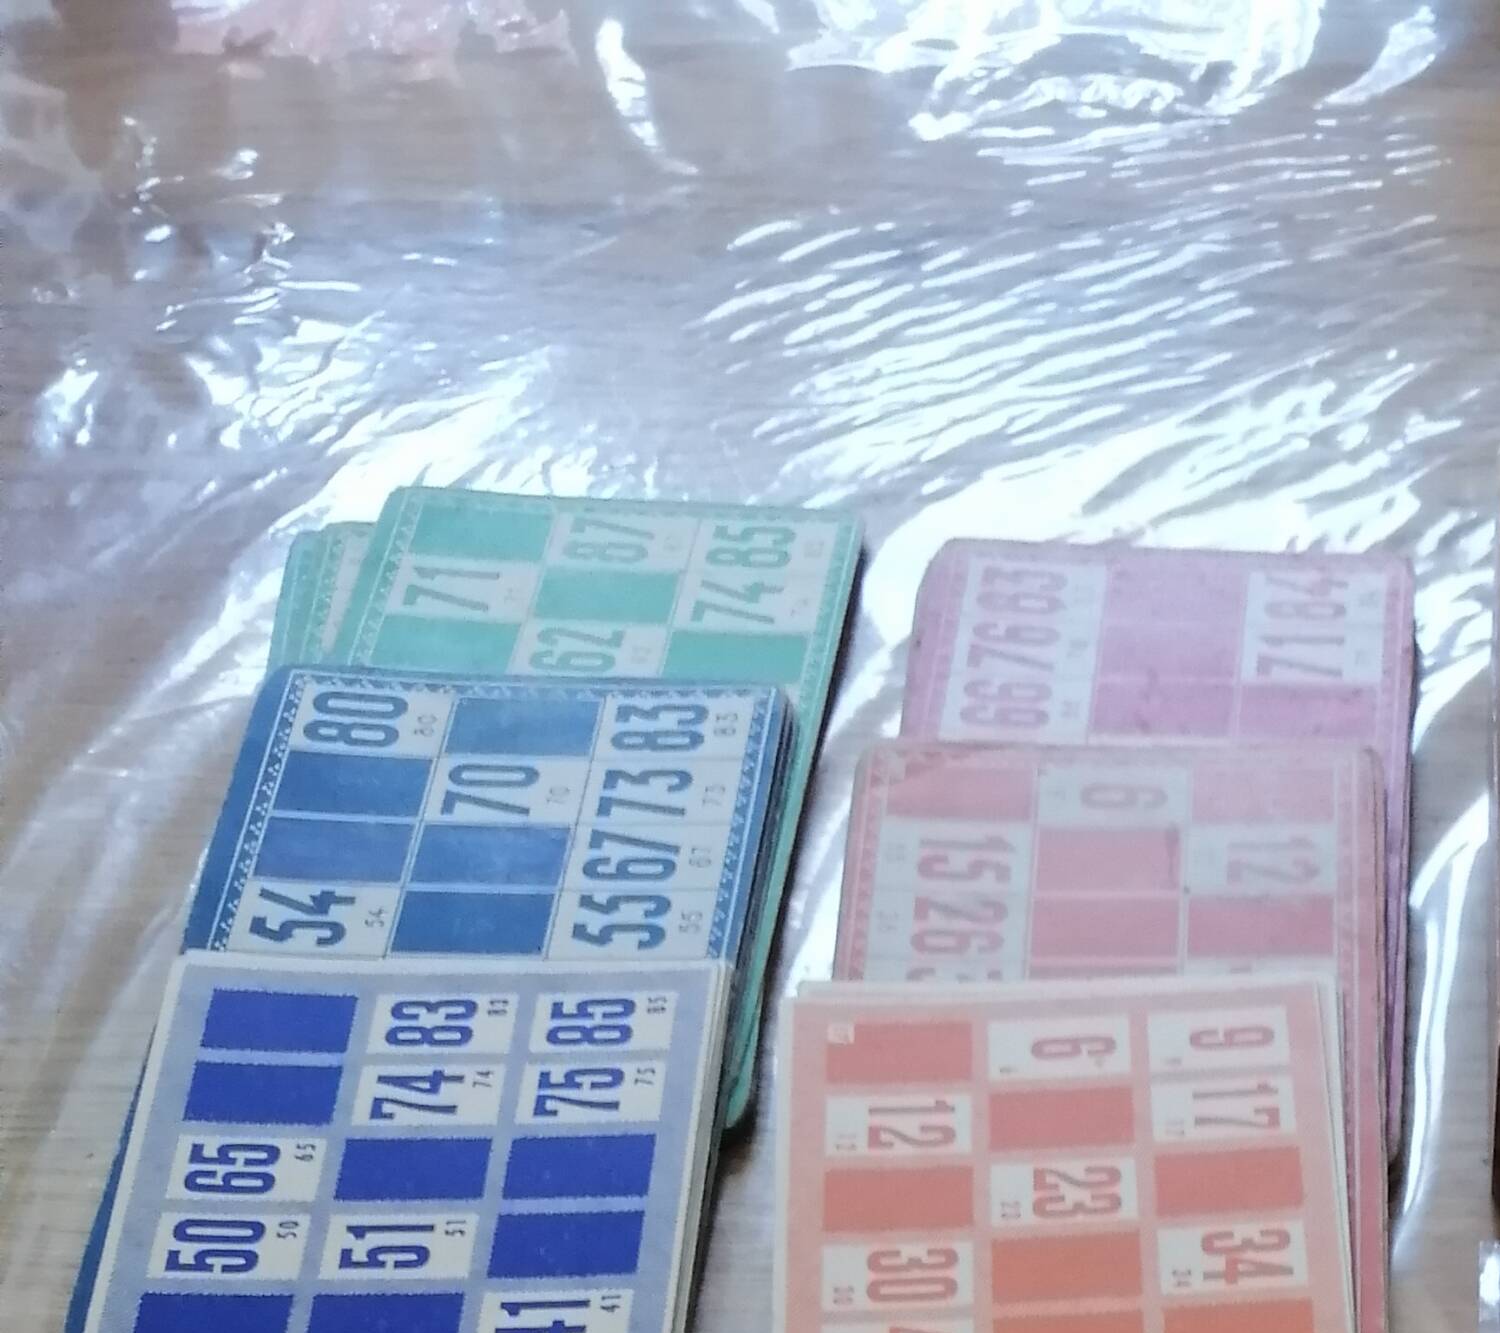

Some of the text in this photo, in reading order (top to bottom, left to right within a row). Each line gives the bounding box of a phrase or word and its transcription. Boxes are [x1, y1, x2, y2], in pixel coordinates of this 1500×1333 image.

[705, 525, 796, 568] 85
[403, 566, 500, 612] 71
[692, 579, 785, 624] 74
[1264, 576, 1349, 620] 84
[529, 627, 626, 672] 62
[967, 622, 1061, 672] 76
[1256, 634, 1345, 677] 71
[303, 691, 408, 747] 80
[960, 680, 1053, 727] 66
[609, 704, 710, 751] 83
[440, 764, 540, 817] 70
[597, 769, 693, 818] 73
[1080, 783, 1168, 808] 6
[582, 829, 681, 881] 67
[917, 834, 1015, 883] 15
[1227, 835, 1320, 883] 12
[249, 888, 356, 946] 54
[572, 894, 672, 950] 55
[910, 897, 1008, 954] 26
[385, 1000, 477, 1046] 83
[546, 999, 635, 1045] 85
[1189, 1026, 1274, 1050] 9
[1031, 1036, 1116, 1060] 6
[370, 1070, 464, 1120] 74
[472, 1070, 493, 1087] 74
[533, 1068, 624, 1117] 75
[634, 1068, 655, 1085] 75
[868, 1100, 956, 1150] 12
[1192, 1081, 1280, 1132] 17
[184, 1144, 280, 1194] 65
[295, 1144, 316, 1161] 65
[1033, 1166, 1121, 1219] 23
[165, 1219, 265, 1273] 50
[277, 1221, 299, 1238] 50
[339, 1225, 434, 1269] 51
[447, 1220, 466, 1236] 51
[866, 1248, 958, 1302] 30
[1201, 1229, 1293, 1286] 34
[603, 1295, 621, 1312] 41
